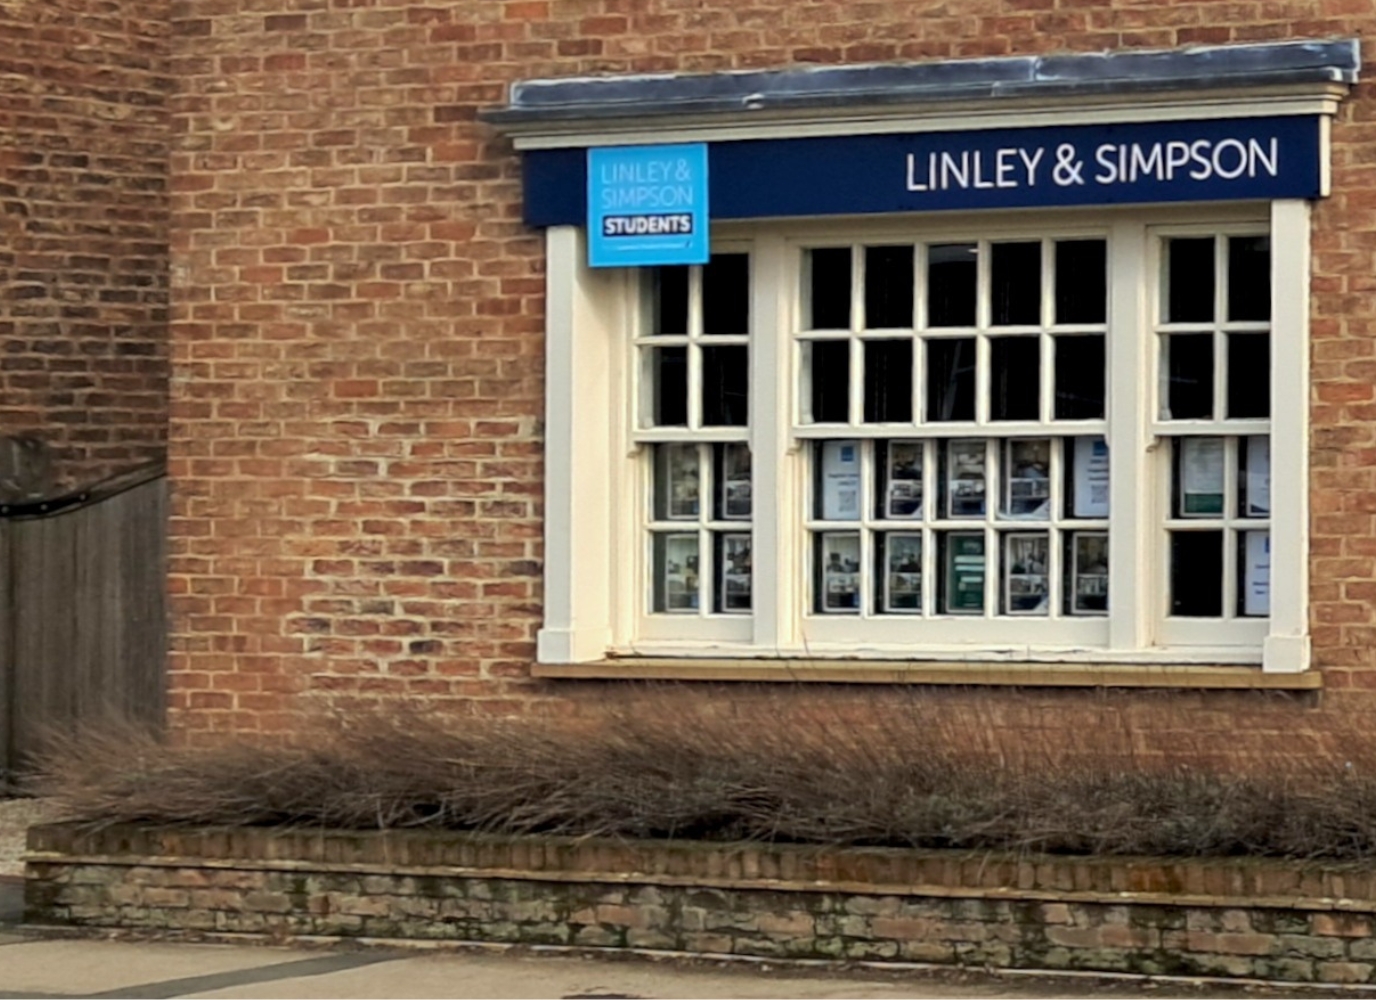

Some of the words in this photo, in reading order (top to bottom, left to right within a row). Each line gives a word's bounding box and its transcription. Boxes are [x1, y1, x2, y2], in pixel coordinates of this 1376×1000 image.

[602, 161, 673, 184] LINLEY
[675, 158, 691, 181] &
[906, 147, 1044, 191] LINLEY
[1052, 144, 1084, 186] &
[1095, 137, 1278, 184] SIMPSON
[602, 185, 693, 209] SIMPSON
[605, 215, 691, 234] STUDENTS
